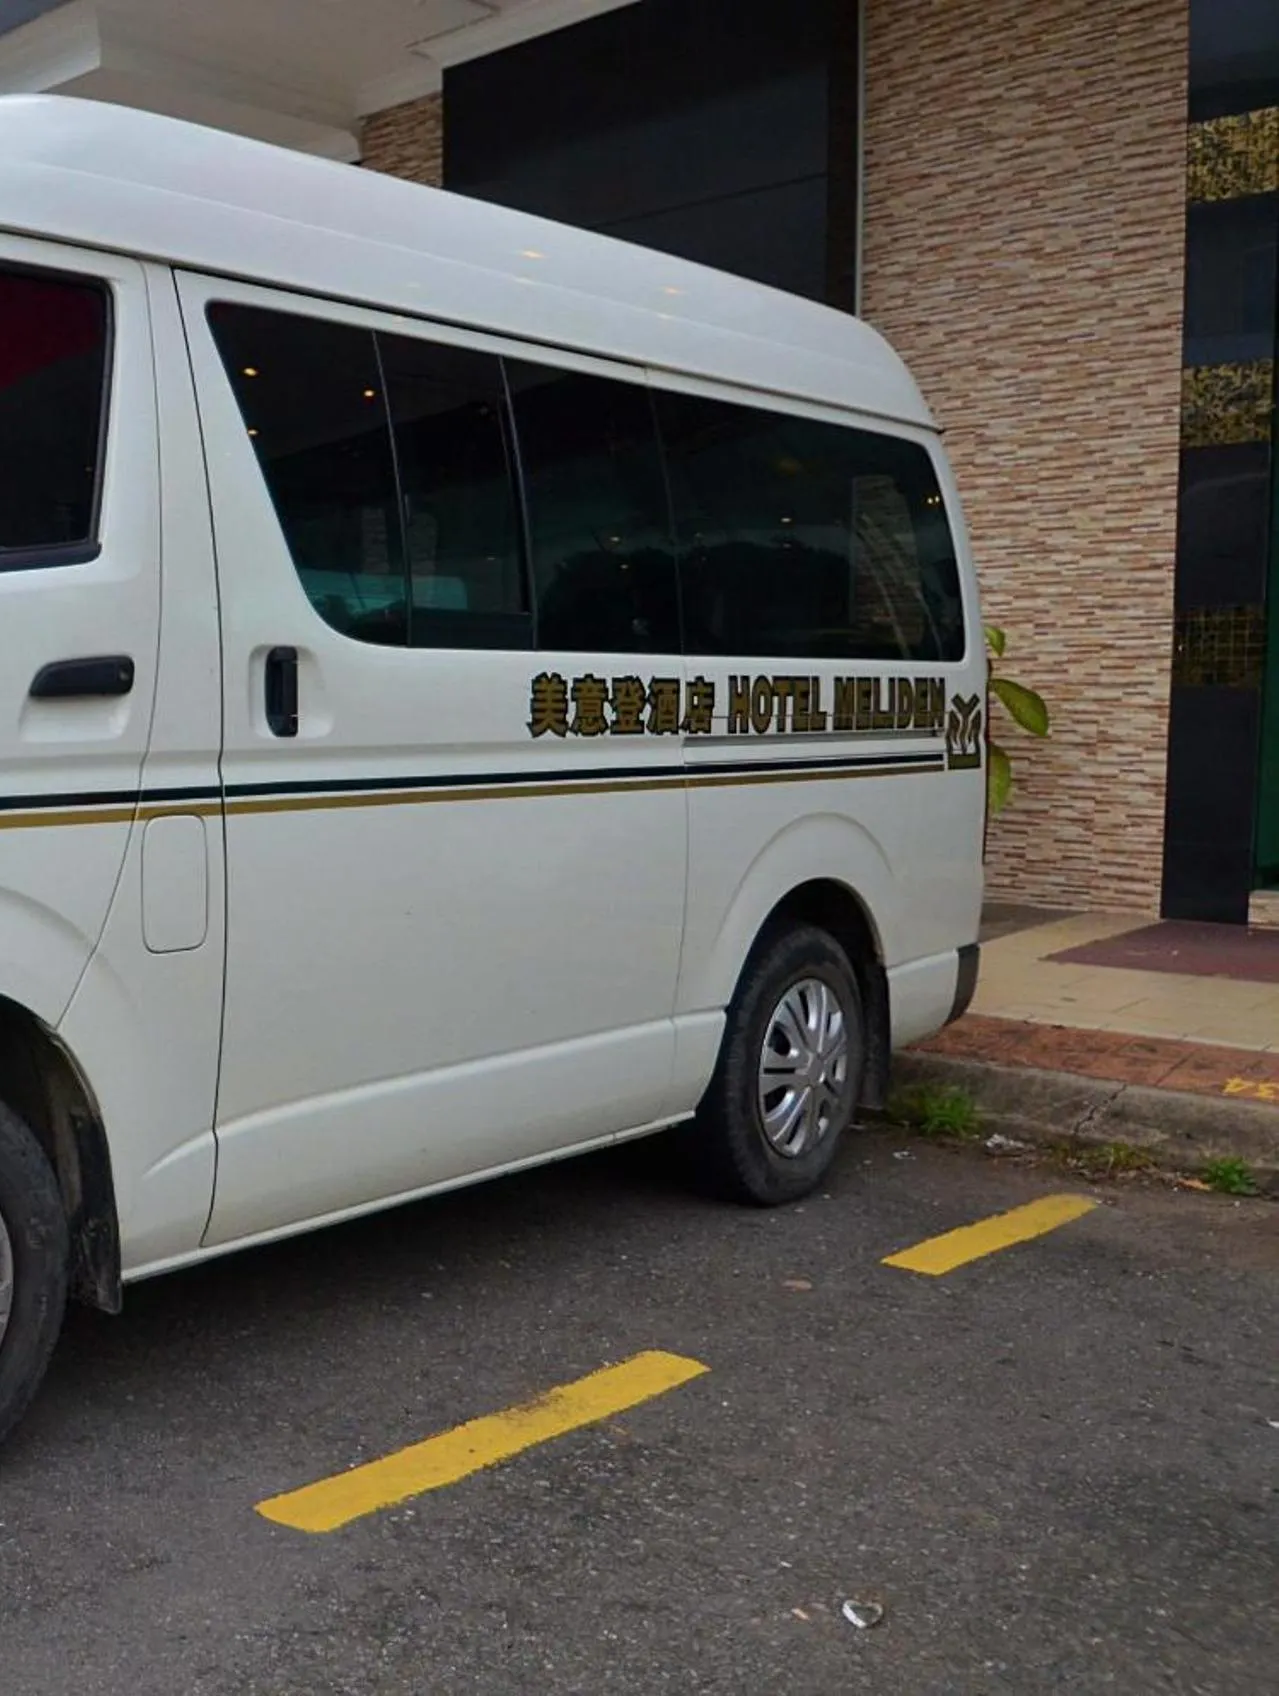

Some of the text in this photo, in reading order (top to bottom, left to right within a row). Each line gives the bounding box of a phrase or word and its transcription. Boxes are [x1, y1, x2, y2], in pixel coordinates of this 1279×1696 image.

[526, 672, 945, 738] 美意登酒店 HOTEL MELIDEN
